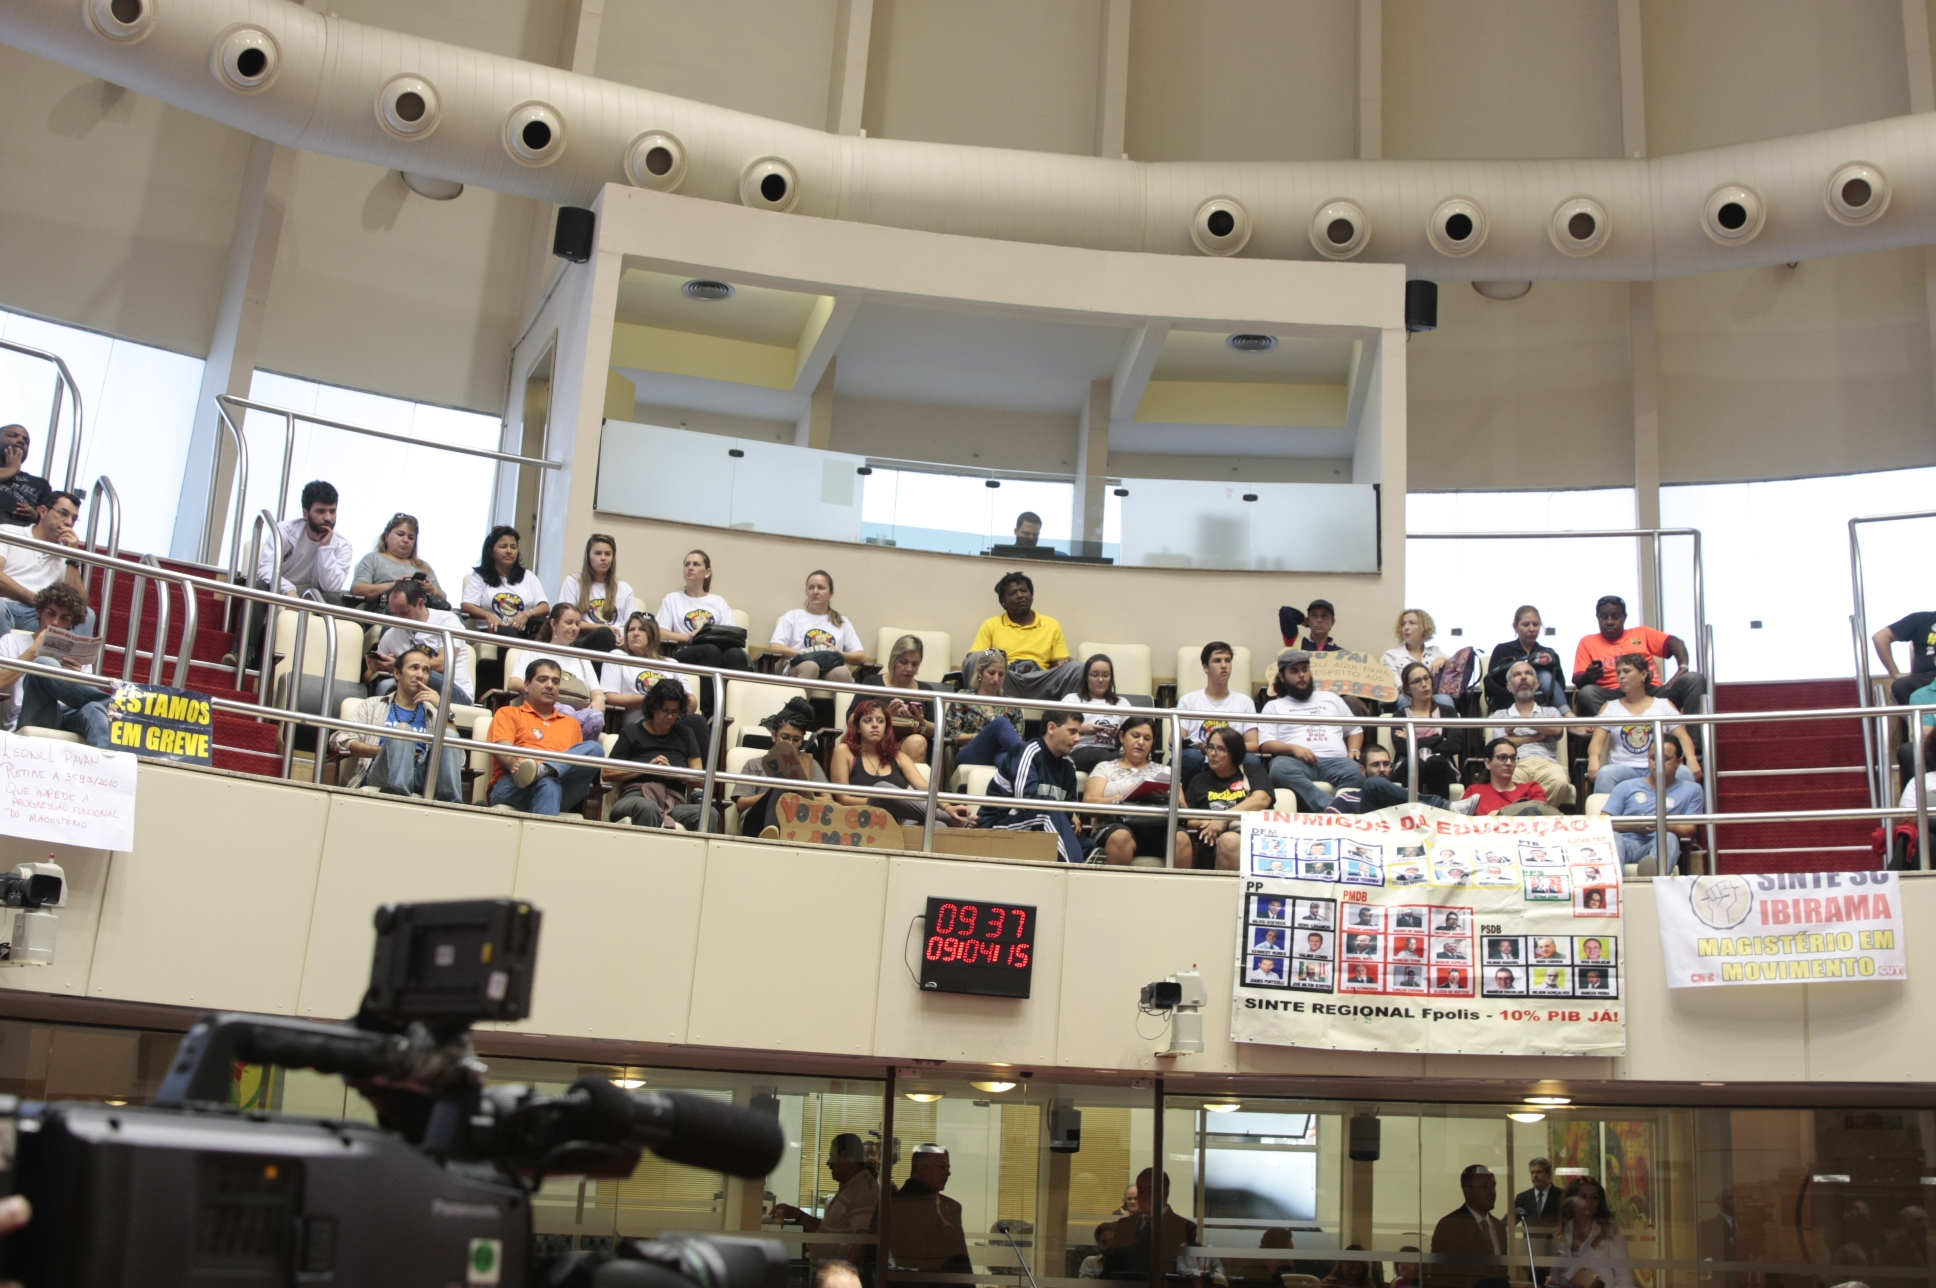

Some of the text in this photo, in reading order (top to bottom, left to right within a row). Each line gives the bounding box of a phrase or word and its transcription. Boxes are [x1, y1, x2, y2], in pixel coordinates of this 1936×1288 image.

[1335, 650, 1368, 664] PAI
[1333, 662, 1358, 670] AQUI
[1363, 666, 1391, 677] PARA
[1365, 674, 1385, 682] AOS
[114, 689, 210, 725] ESTAMOS
[111, 721, 209, 758] EM GREVE
[63, 749, 100, 767] PAVAN
[0, 761, 46, 780] RETIRE
[52, 772, 60, 782] A
[5, 781, 30, 797] QUE
[82, 794, 90, 804] A
[4, 808, 20, 818] DO
[73, 806, 120, 819] FUNCIONAL
[780, 795, 888, 831] VOTE COM
[1263, 811, 1590, 837] INIMIGOS DA EDUCAÇÃO
[808, 830, 863, 847] AMOR
[1246, 881, 1264, 892] PP
[1757, 873, 1841, 891] SINTE
[1343, 890, 1368, 902] PMDB
[1759, 893, 1893, 926] IBIRAMA
[936, 903, 1026, 938] 09 37
[1480, 925, 1502, 934] PSDB
[1697, 929, 1896, 957] MAGISTÉRIO EM
[1691, 972, 1715, 983] CNE
[1721, 956, 1876, 982] MOVIMENTO
[1245, 998, 1305, 1012] SINTE
[1312, 1003, 1415, 1019] REGIONAL
[1421, 1008, 1480, 1022] Fpolis
[1499, 1010, 1541, 1022] 10%
[1548, 1011, 1581, 1022] PIB
[1587, 1008, 1619, 1022] JÁ!
